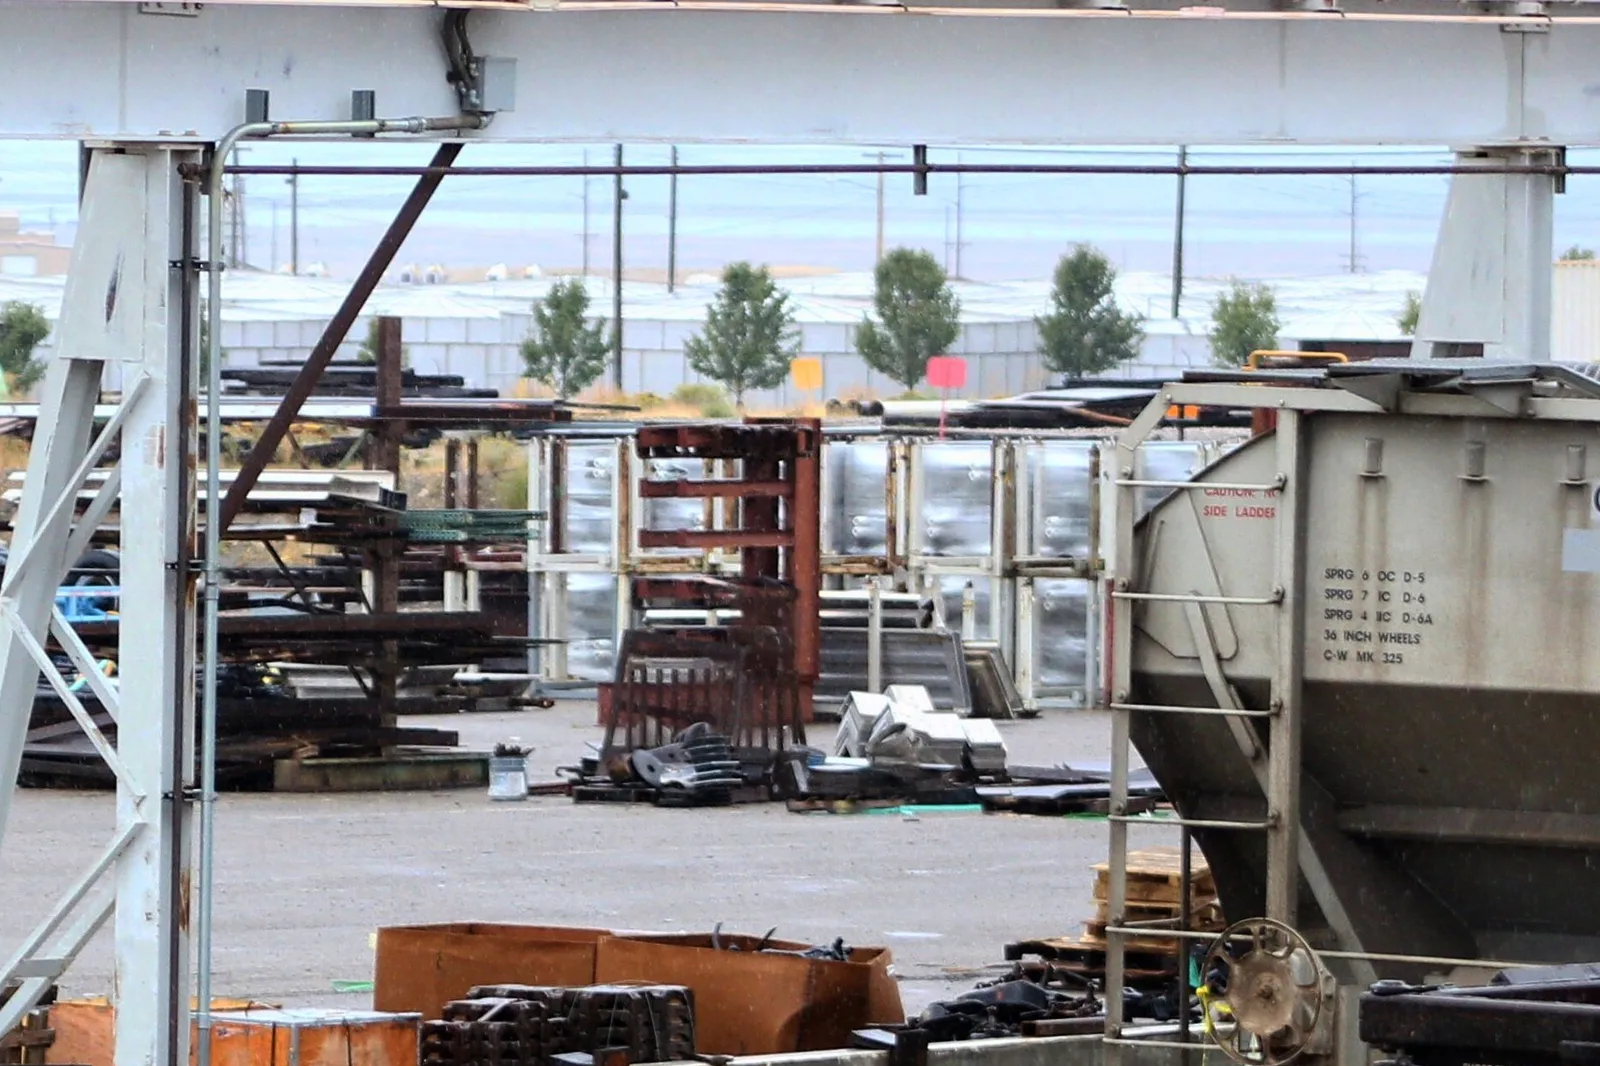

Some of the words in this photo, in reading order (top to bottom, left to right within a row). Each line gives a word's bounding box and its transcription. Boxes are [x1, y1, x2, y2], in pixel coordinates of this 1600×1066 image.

[1203, 505, 1228, 516] SIDE
[1324, 568, 1354, 580] SPRG
[1362, 570, 1369, 580] 6
[1377, 571, 1396, 582] OC
[1403, 572, 1425, 583] D-5
[1324, 588, 1353, 600] SPRG
[1361, 590, 1368, 600] 7
[1402, 592, 1425, 603] D-6
[1324, 608, 1353, 620] SPRG
[1402, 612, 1433, 625] D-6A
[1323, 629, 1337, 640] 36
[1343, 630, 1372, 642] INCH
[1378, 632, 1421, 644] WHEELS
[1323, 649, 1348, 661] C-W
[1356, 651, 1374, 663] MK
[1382, 653, 1403, 664] 325
